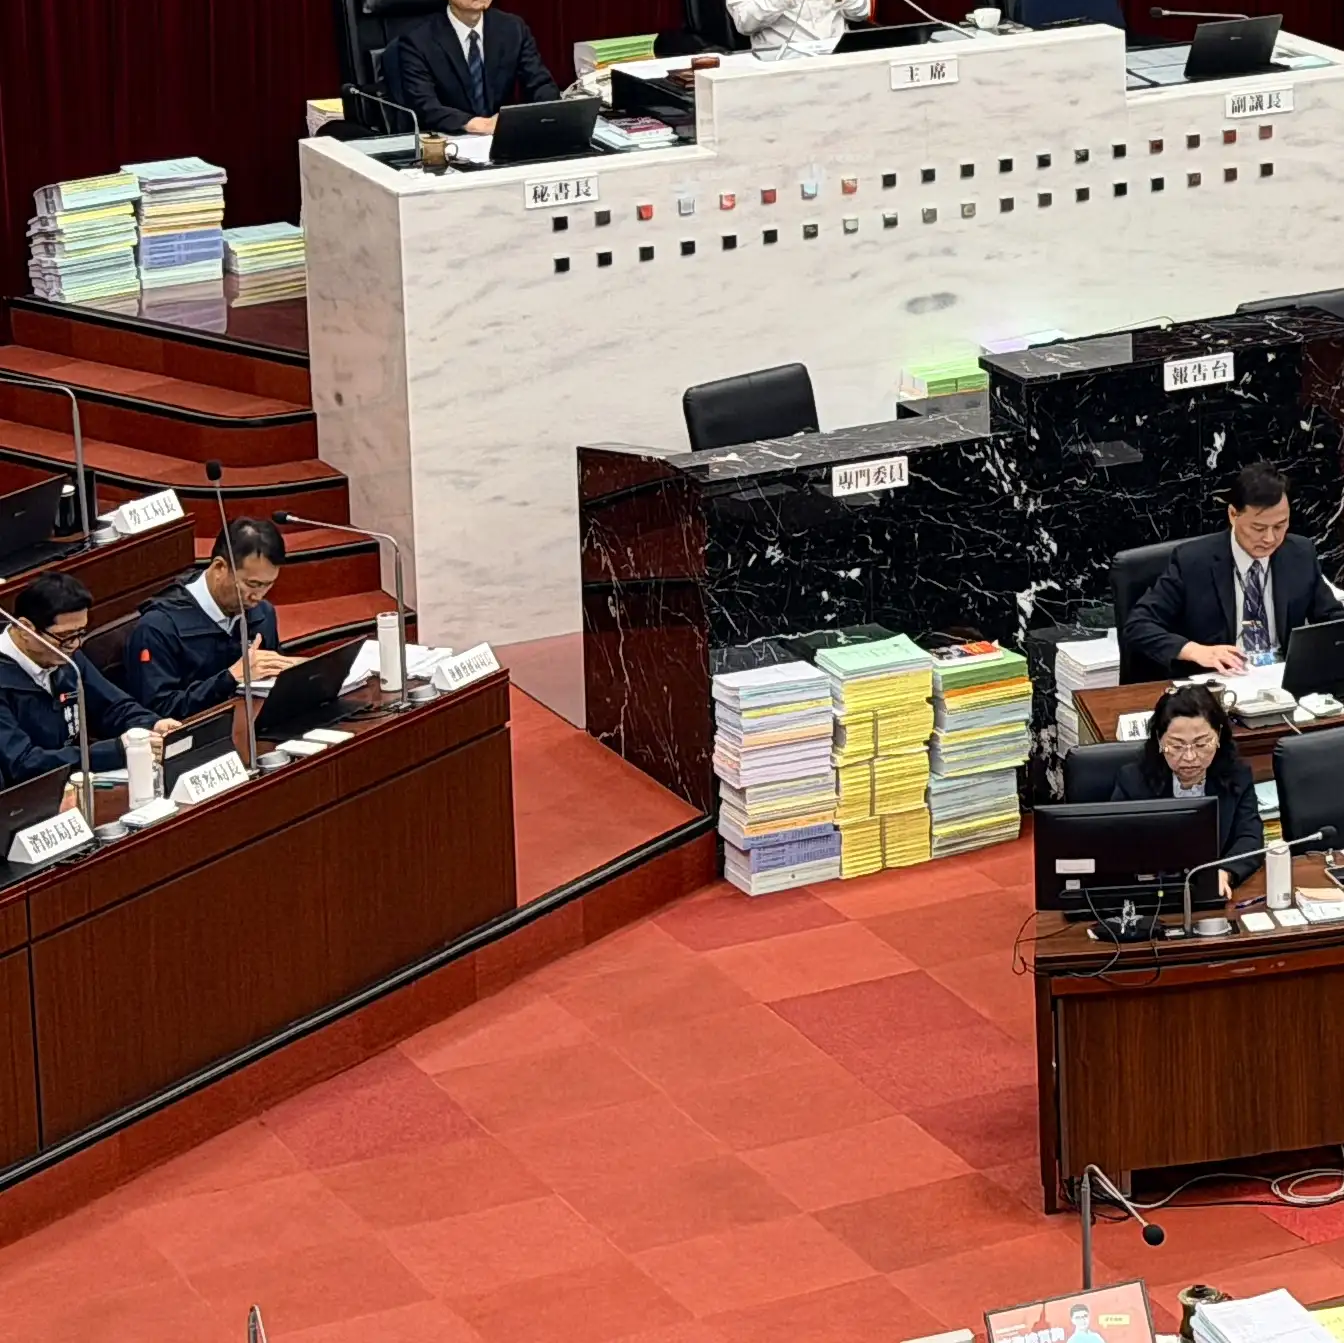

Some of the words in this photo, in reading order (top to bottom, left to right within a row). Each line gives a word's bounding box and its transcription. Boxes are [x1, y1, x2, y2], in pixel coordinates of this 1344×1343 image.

[903, 62, 946, 84] 主席
[1230, 92, 1282, 115] 副議長
[532, 178, 592, 204] 秘書長
[1172, 360, 1228, 386] 報告台
[837, 462, 905, 490] 專門委員
[128, 495, 177, 526] 勞工局長
[189, 757, 242, 795] 警察局長
[29, 817, 84, 854] 消防局長
